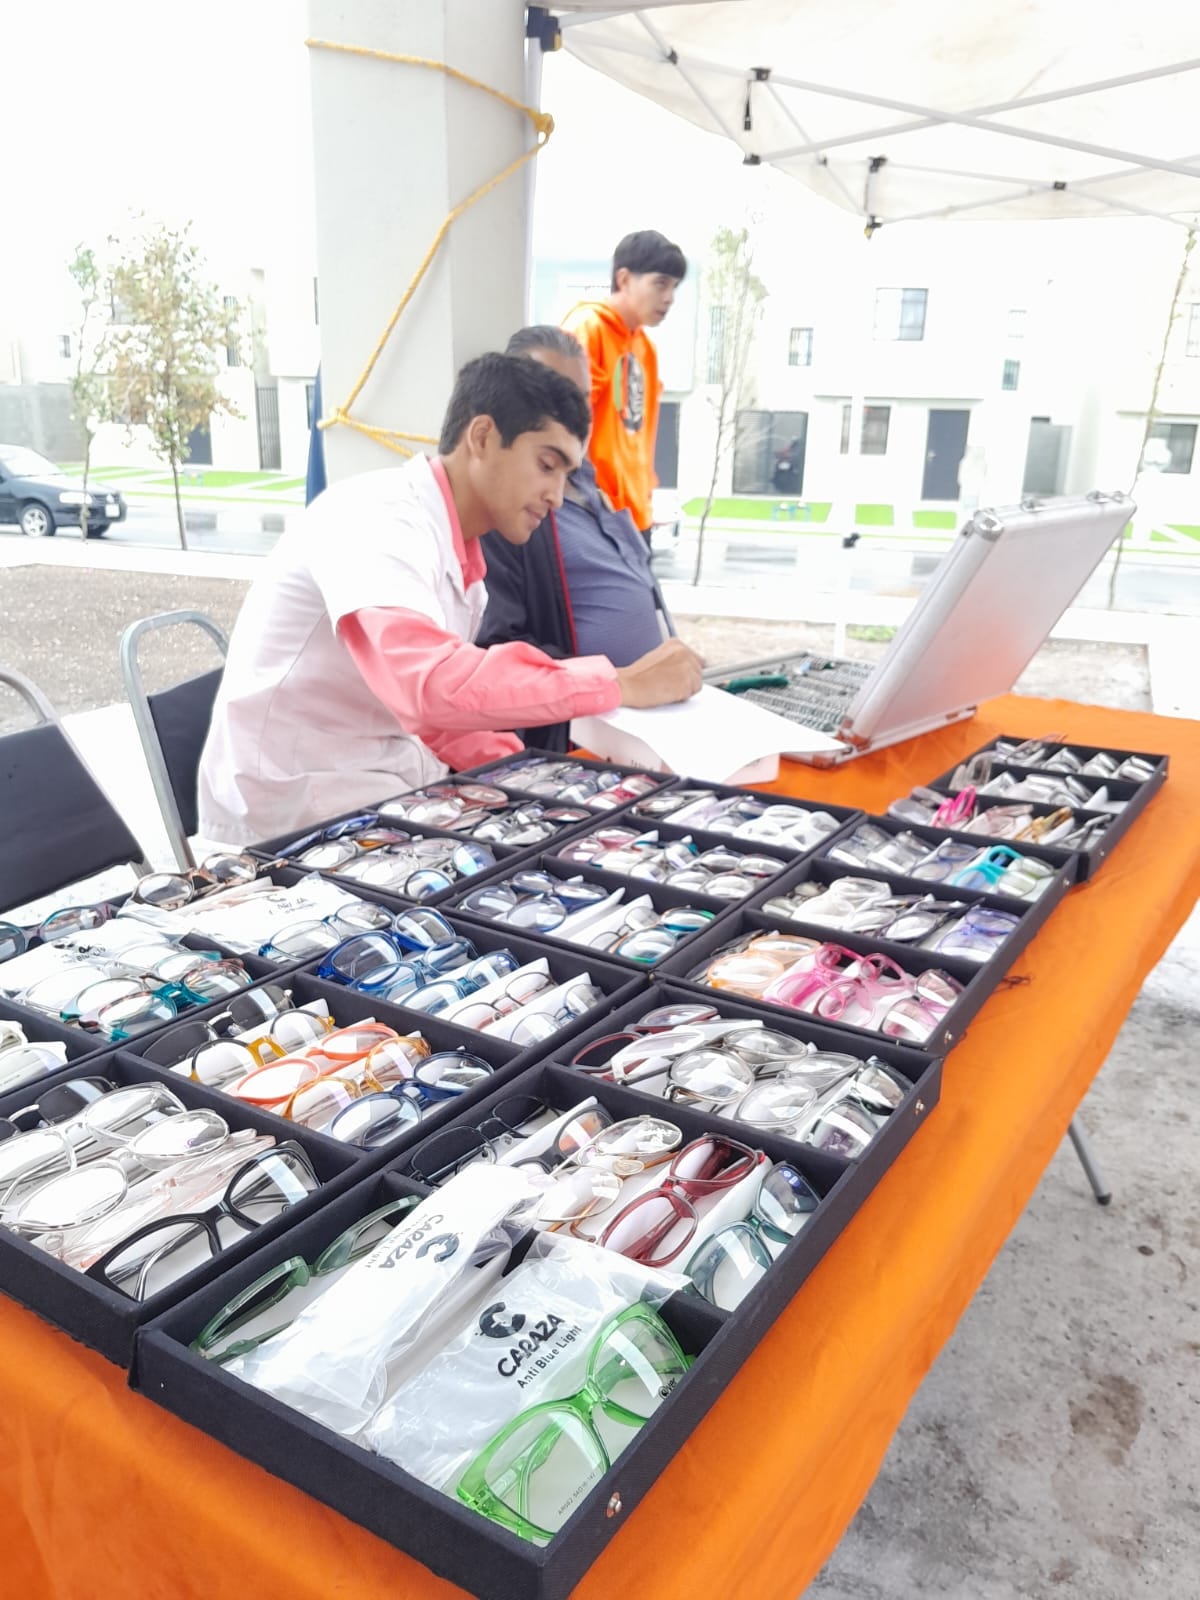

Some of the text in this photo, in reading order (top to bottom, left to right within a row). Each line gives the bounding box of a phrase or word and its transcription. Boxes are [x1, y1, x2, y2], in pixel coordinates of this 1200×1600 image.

[378, 1214, 444, 1268] CARAZA
[497, 1314, 565, 1377] CARAZA
[517, 1325, 582, 1388] Anti Blue Light
